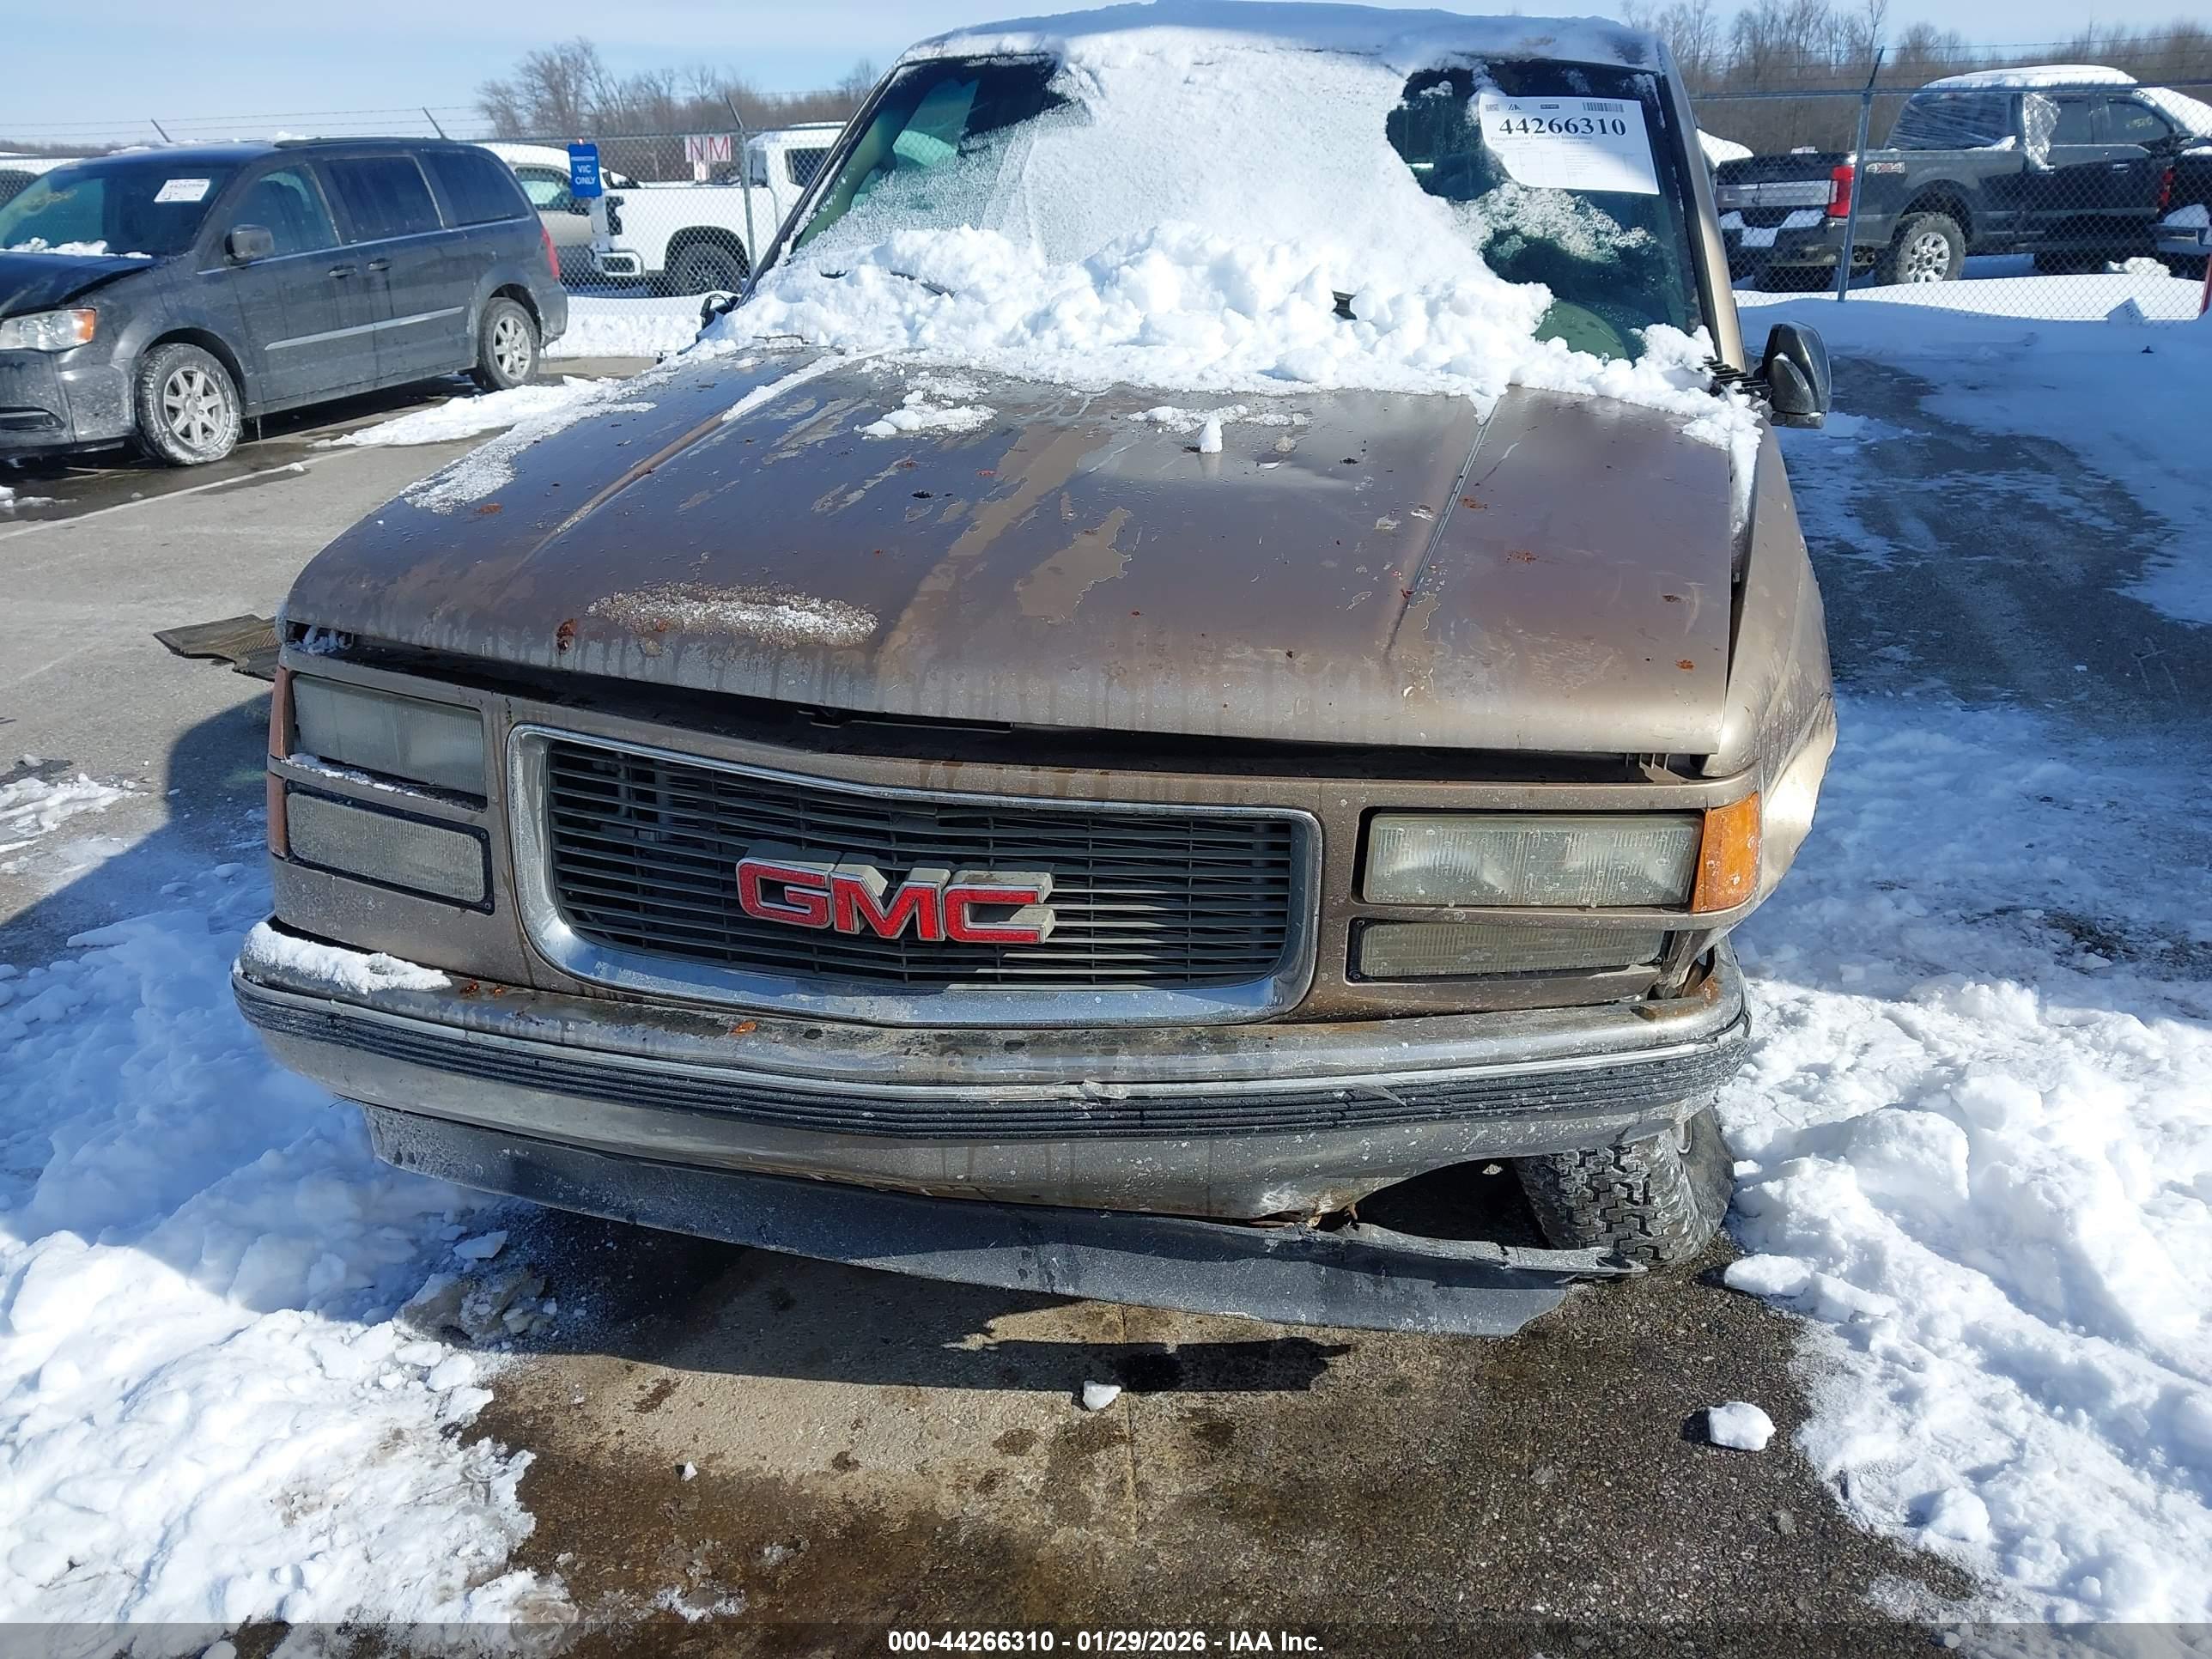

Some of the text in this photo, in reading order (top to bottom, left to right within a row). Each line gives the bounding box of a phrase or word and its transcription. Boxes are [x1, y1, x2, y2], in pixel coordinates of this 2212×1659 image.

[1498, 117, 1626, 136] 44266310
[576, 164, 592, 173] VIC
[574, 176, 596, 185] ONLY
[736, 857, 1055, 944] GMC
